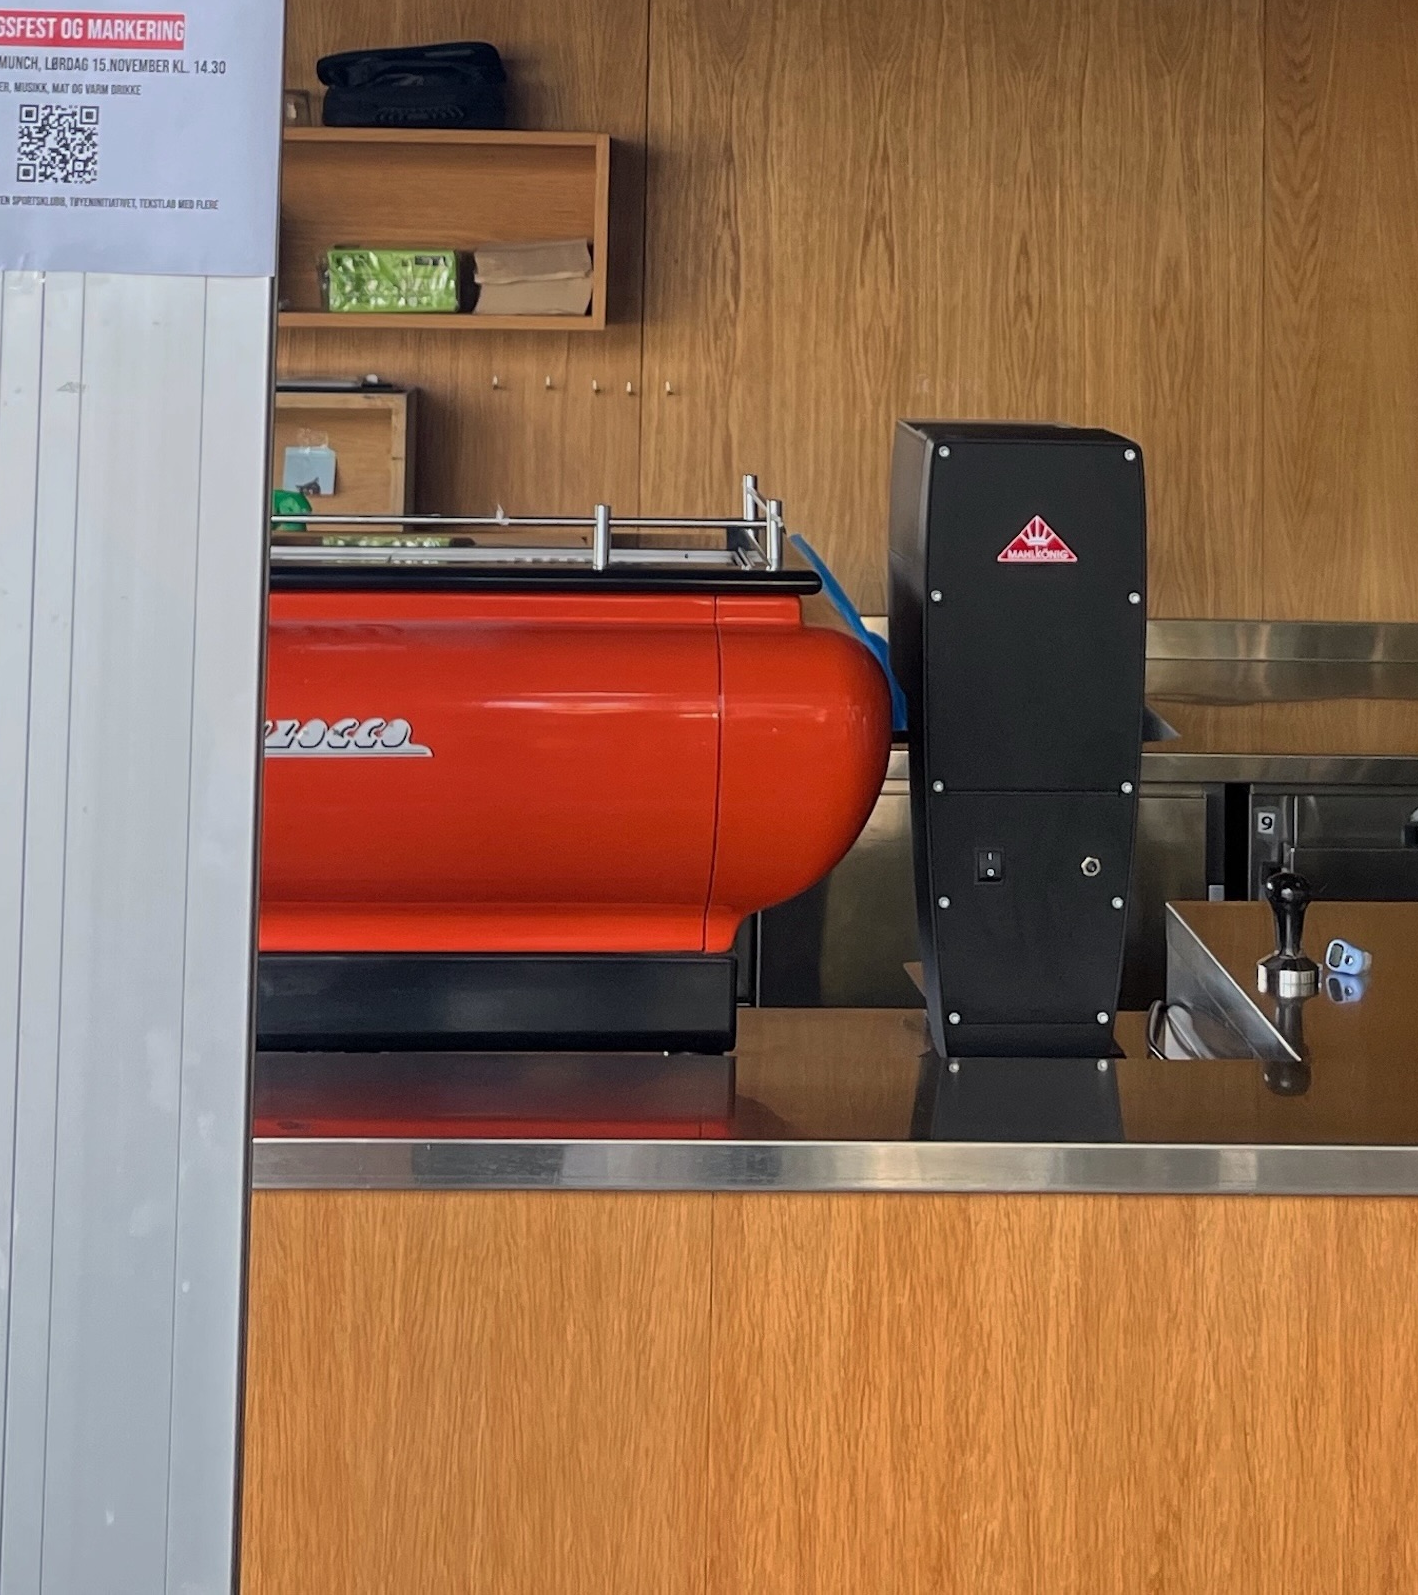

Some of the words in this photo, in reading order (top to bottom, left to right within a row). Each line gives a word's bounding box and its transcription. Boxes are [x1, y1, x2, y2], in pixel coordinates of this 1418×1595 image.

[60, 17, 83, 40] OG
[87, 19, 185, 42] MARKERING
[45, 57, 89, 71] LØRDAG
[92, 58, 170, 73] 15.NOVEMBER
[172, 60, 190, 74] KL.
[194, 60, 226, 74] 14.30
[52, 83, 70, 94] MAT
[72, 83, 83, 94] OG
[85, 83, 109, 95] VARM
[1261, 816, 1273, 831] 9
